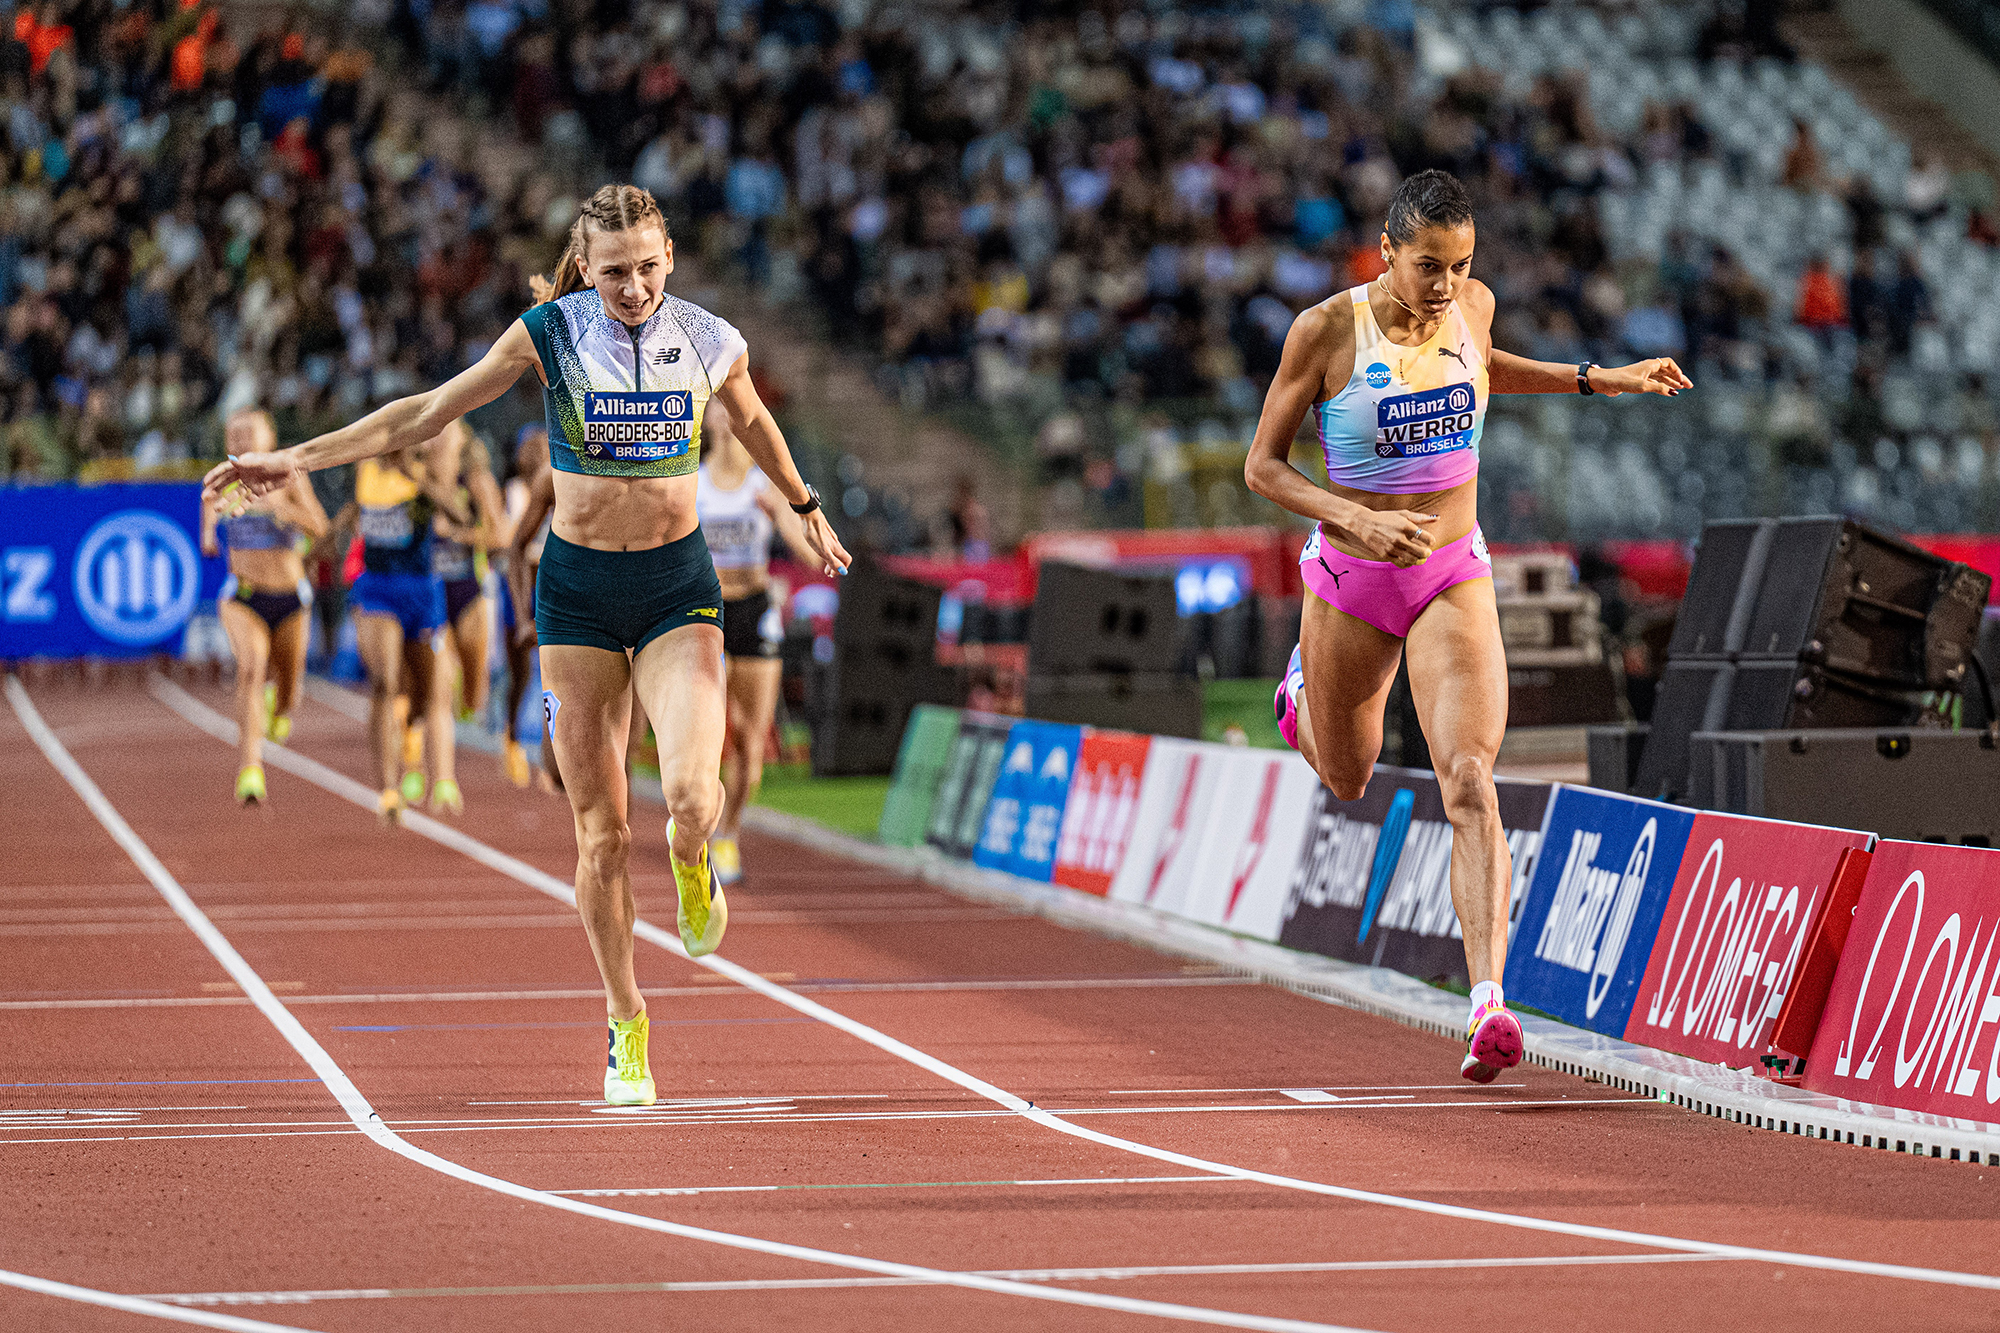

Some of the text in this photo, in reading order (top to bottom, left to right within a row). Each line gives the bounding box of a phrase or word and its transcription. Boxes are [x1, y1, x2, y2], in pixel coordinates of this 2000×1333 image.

[593, 398, 659, 415] Allianz
[1386, 398, 1446, 421] Allianz
[588, 421, 689, 442] BROEDERS-BOL
[1383, 412, 1473, 443] WERRO
[615, 444, 679, 458] BRUSSELS
[1405, 435, 1465, 455] BRUSSELS
[1534, 828, 1622, 974] Allianz
[1683, 876, 1819, 1051] OMEGA
